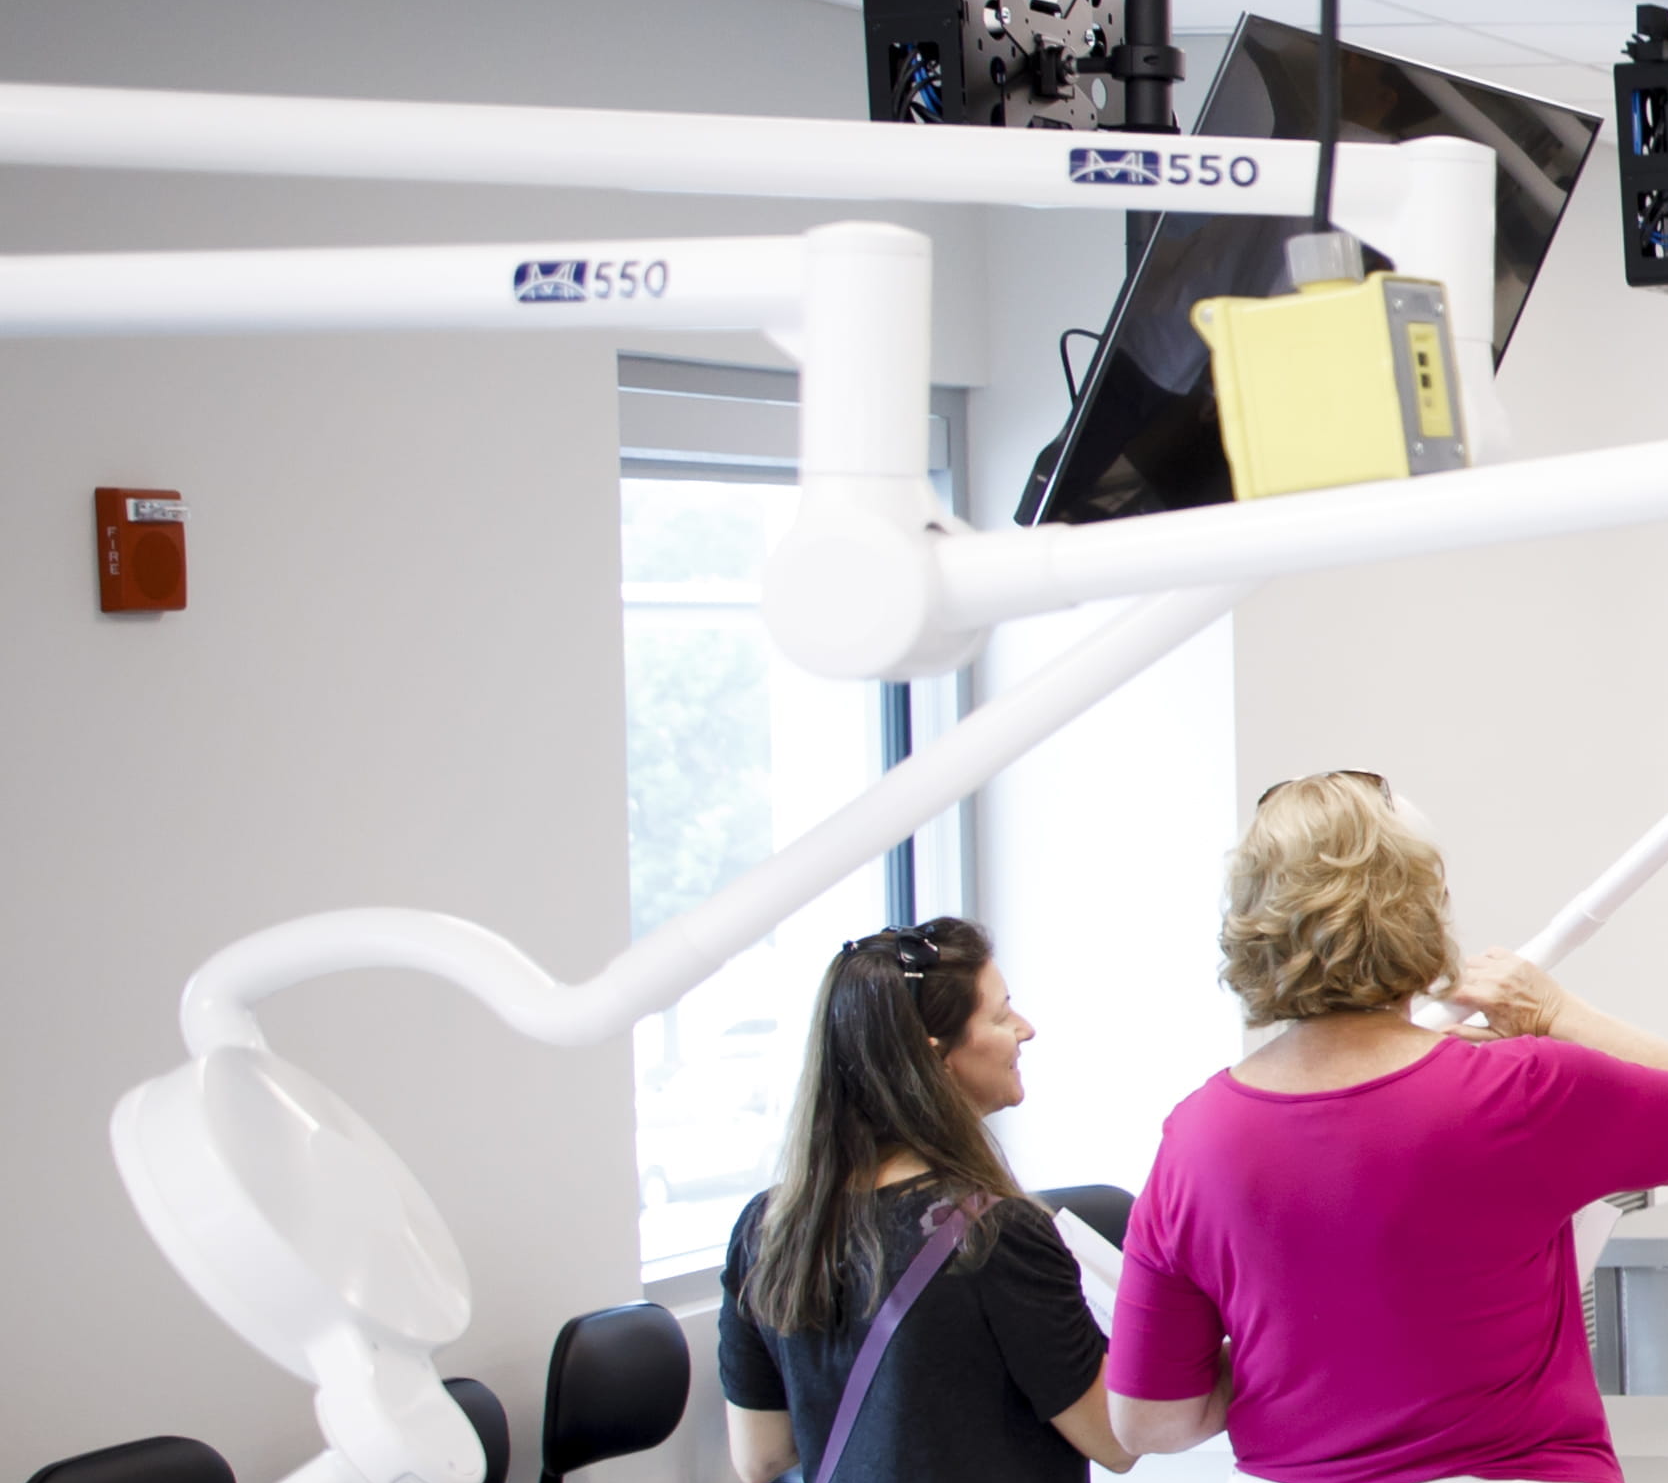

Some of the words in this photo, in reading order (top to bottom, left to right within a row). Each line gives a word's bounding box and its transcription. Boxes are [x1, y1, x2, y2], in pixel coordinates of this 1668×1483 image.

[1168, 154, 1257, 188] 550
[594, 260, 670, 299] 550
[106, 525, 121, 576] FIRE
